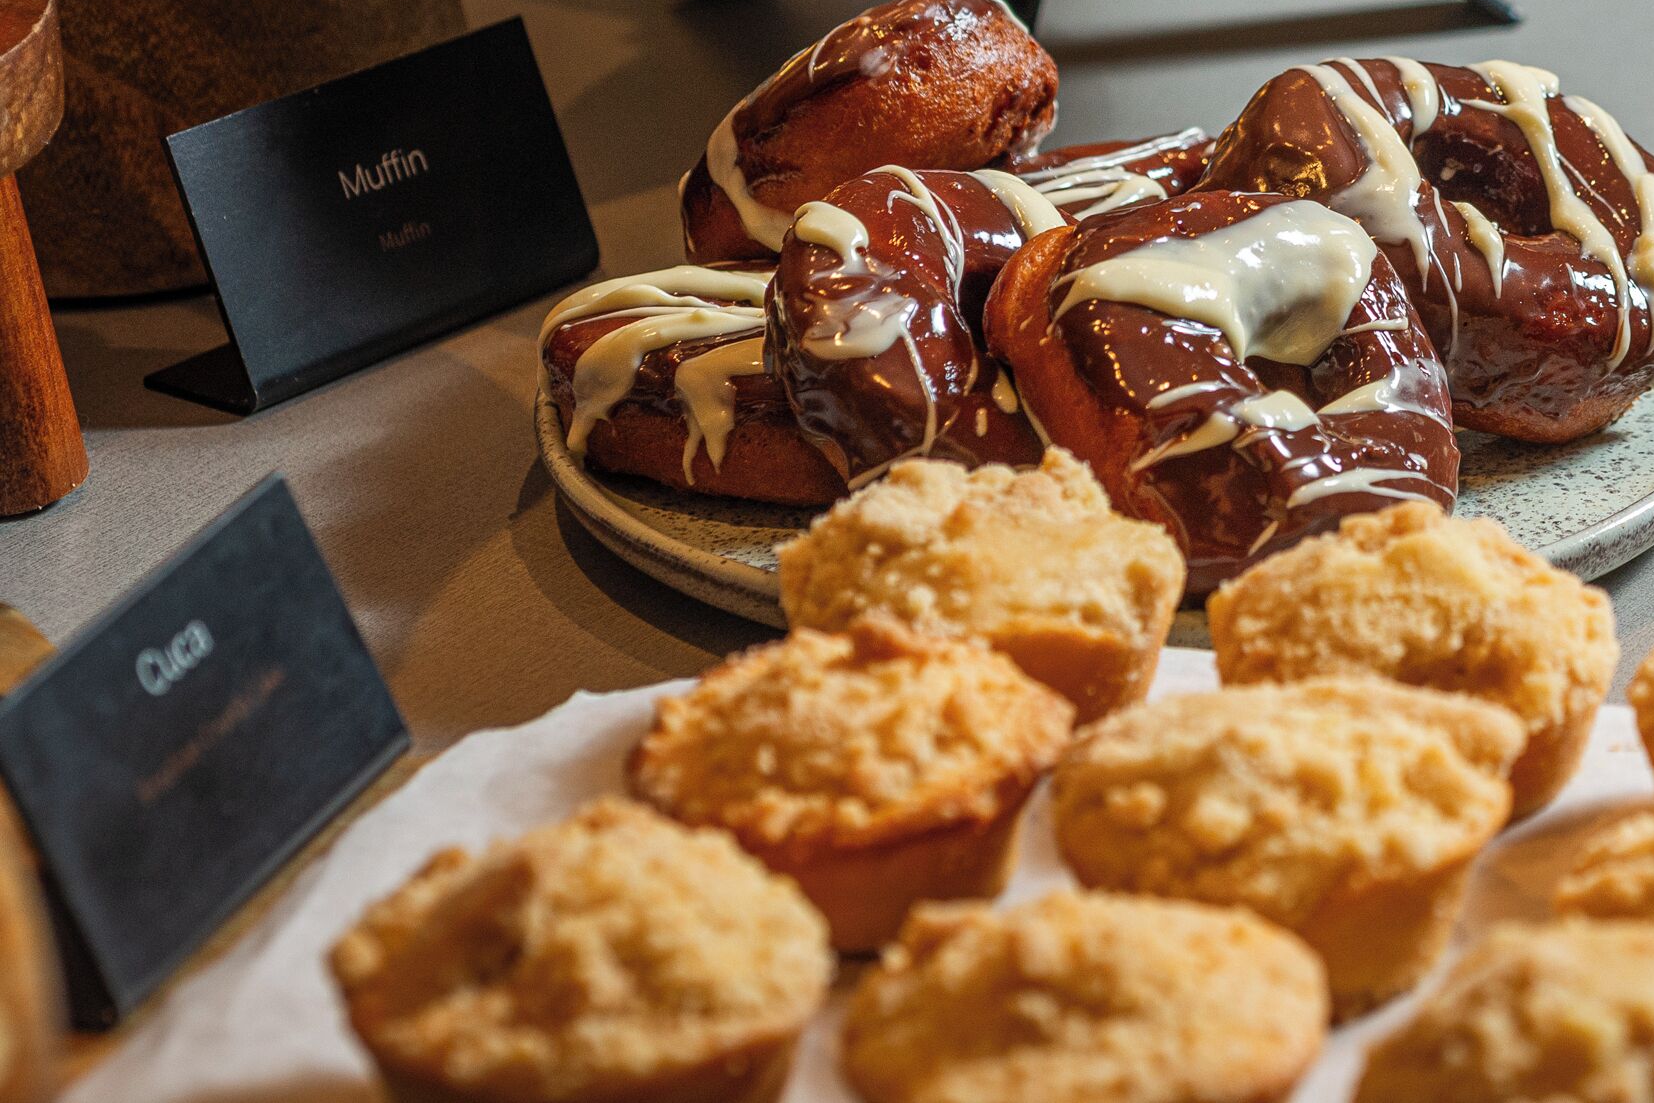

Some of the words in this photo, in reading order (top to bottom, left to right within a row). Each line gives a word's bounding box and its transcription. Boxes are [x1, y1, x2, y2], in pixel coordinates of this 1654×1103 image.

[337, 147, 429, 200] Muffin
[378, 220, 431, 252] Muffin
[135, 618, 215, 697] Cuca
